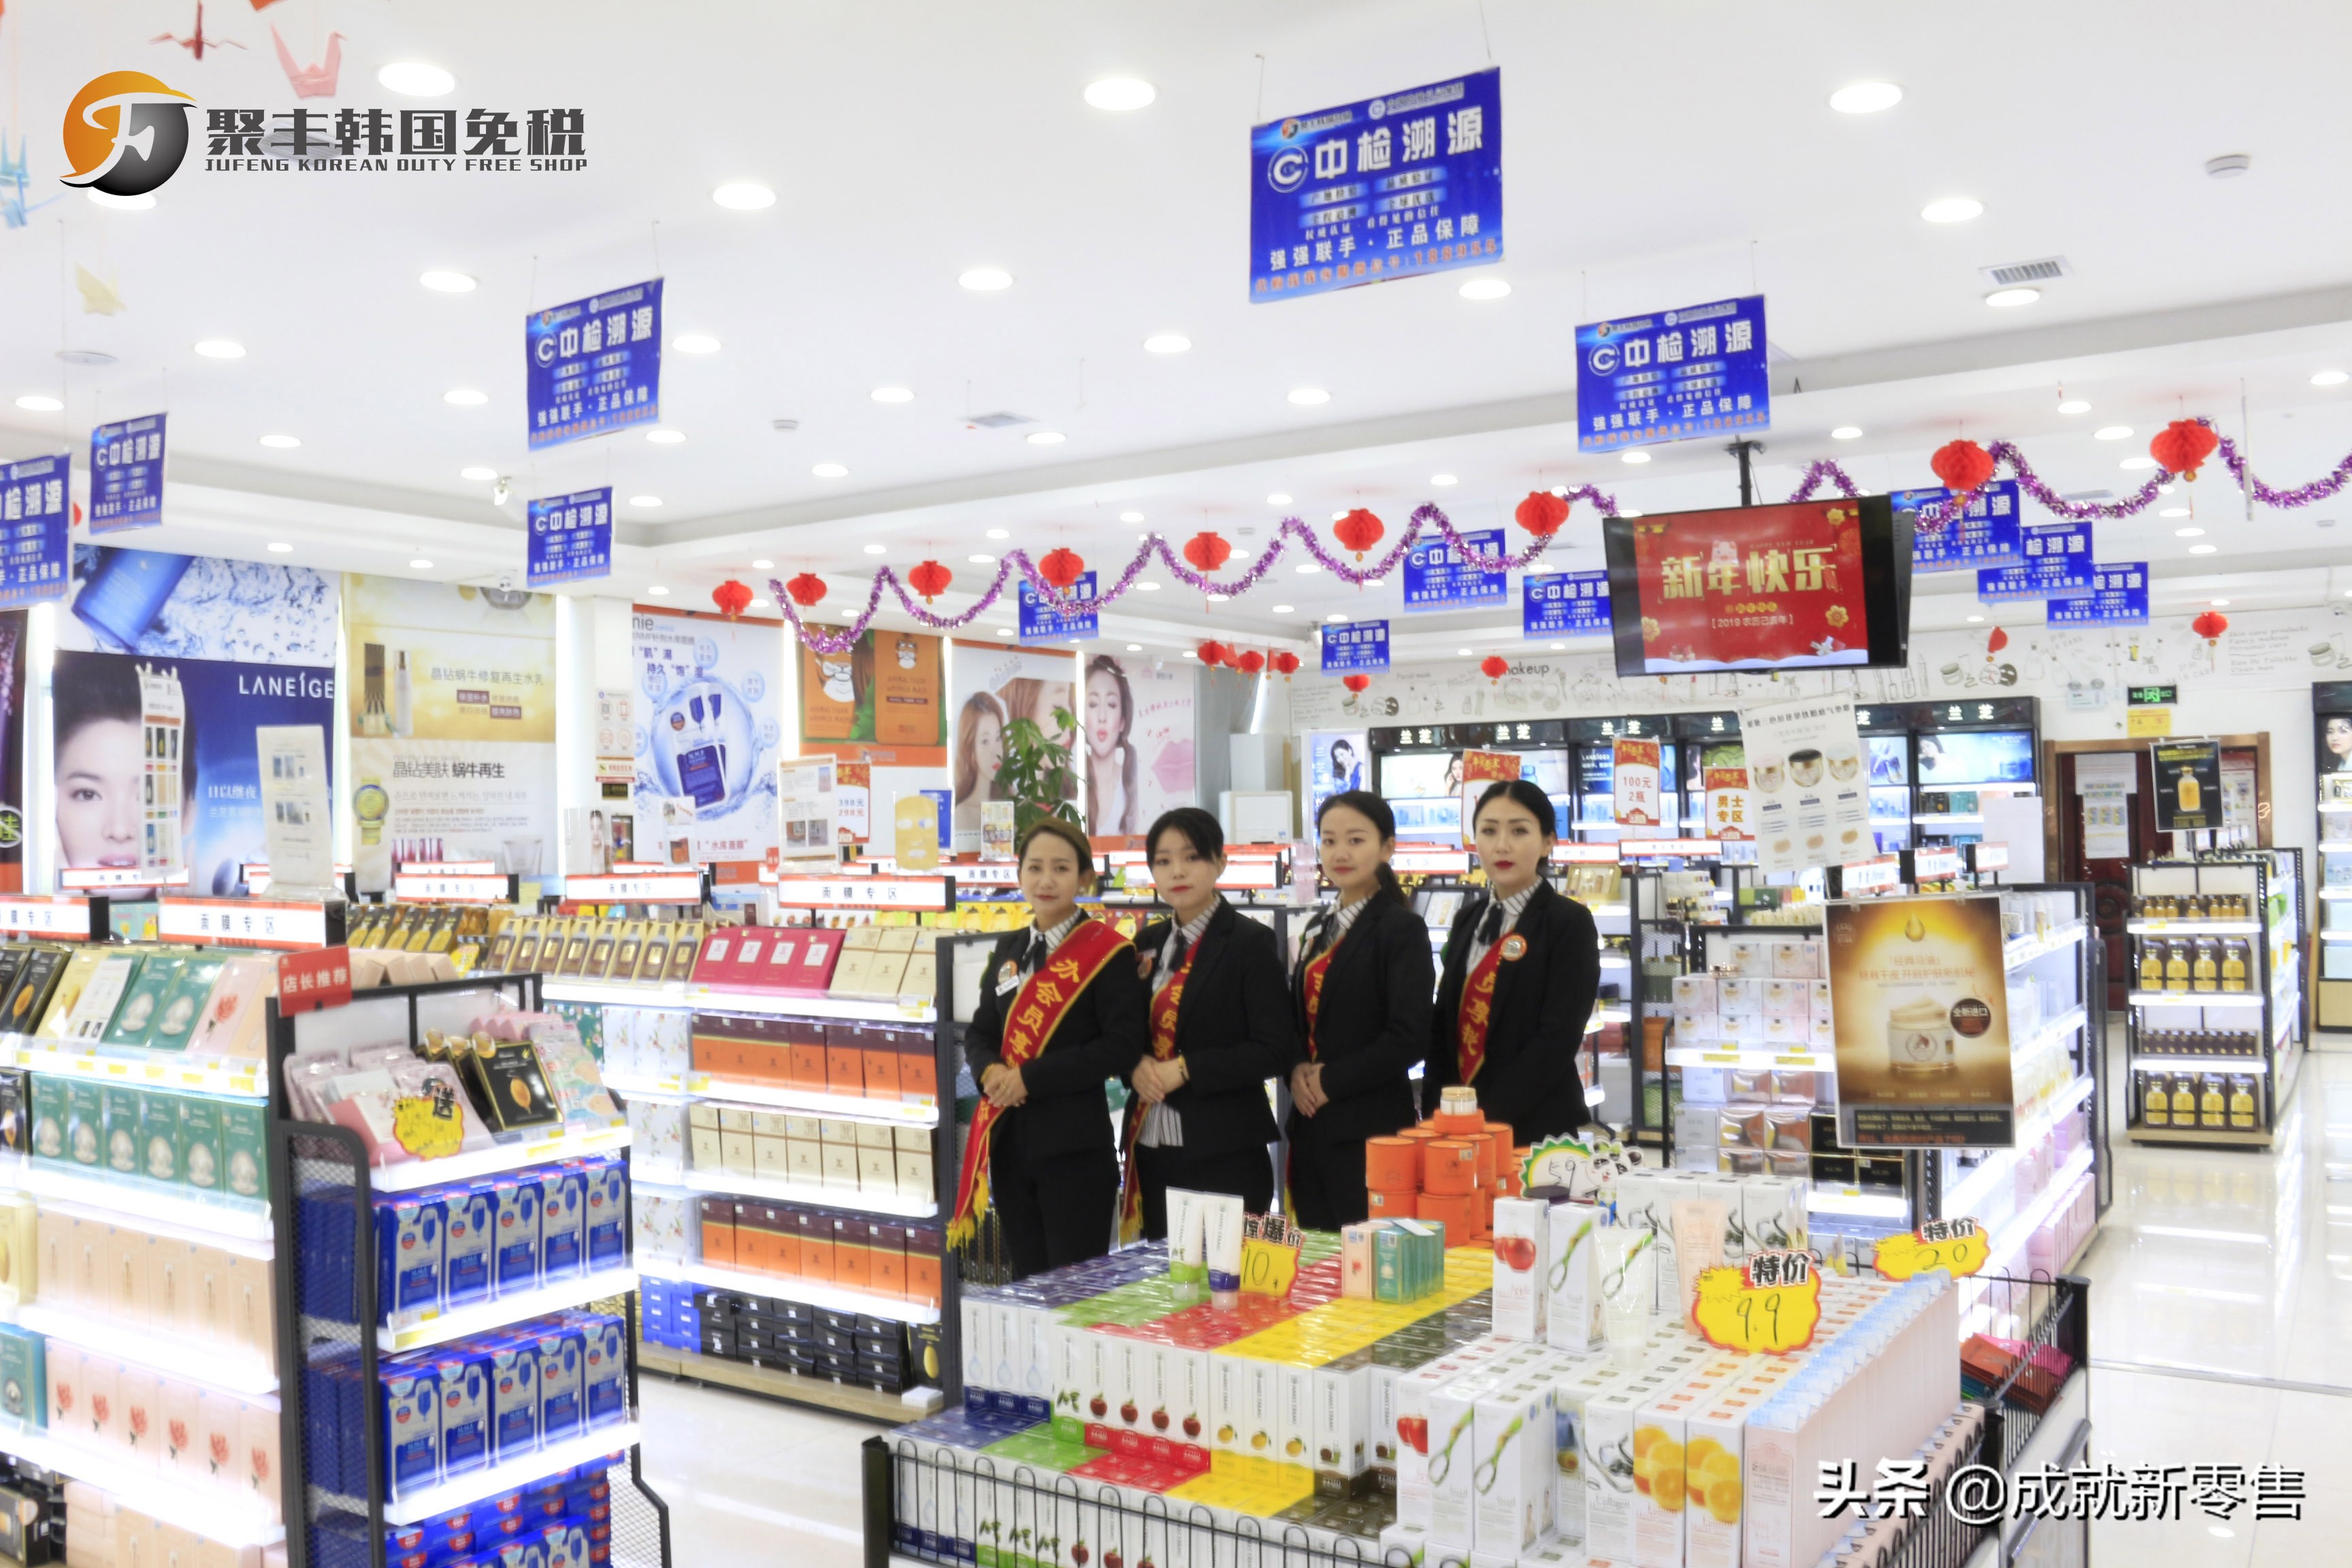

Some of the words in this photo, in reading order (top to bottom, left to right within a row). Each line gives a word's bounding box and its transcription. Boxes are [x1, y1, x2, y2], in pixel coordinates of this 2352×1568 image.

[1315, 105, 1484, 180] 中检溯源
[1624, 319, 1753, 368] 中检溯源
[1661, 544, 1838, 600] 新年快乐
[1947, 704, 1995, 721] 兰芝
[1399, 728, 1433, 745] 兰芝
[1497, 723, 1531, 740] 兰芝
[1623, 776, 1652, 789] 100元
[1716, 795, 1744, 808] 男士
[1716, 810, 1744, 823] 专区
[822, 886, 897, 900] 面膜专区
[0, 909, 53, 928] 膜专区
[282, 966, 348, 995] 店长推荐
[1952, 1007, 1989, 1018] 全新进口
[1922, 1218, 1976, 1242] 特价
[1750, 1253, 1811, 1286] 特价
